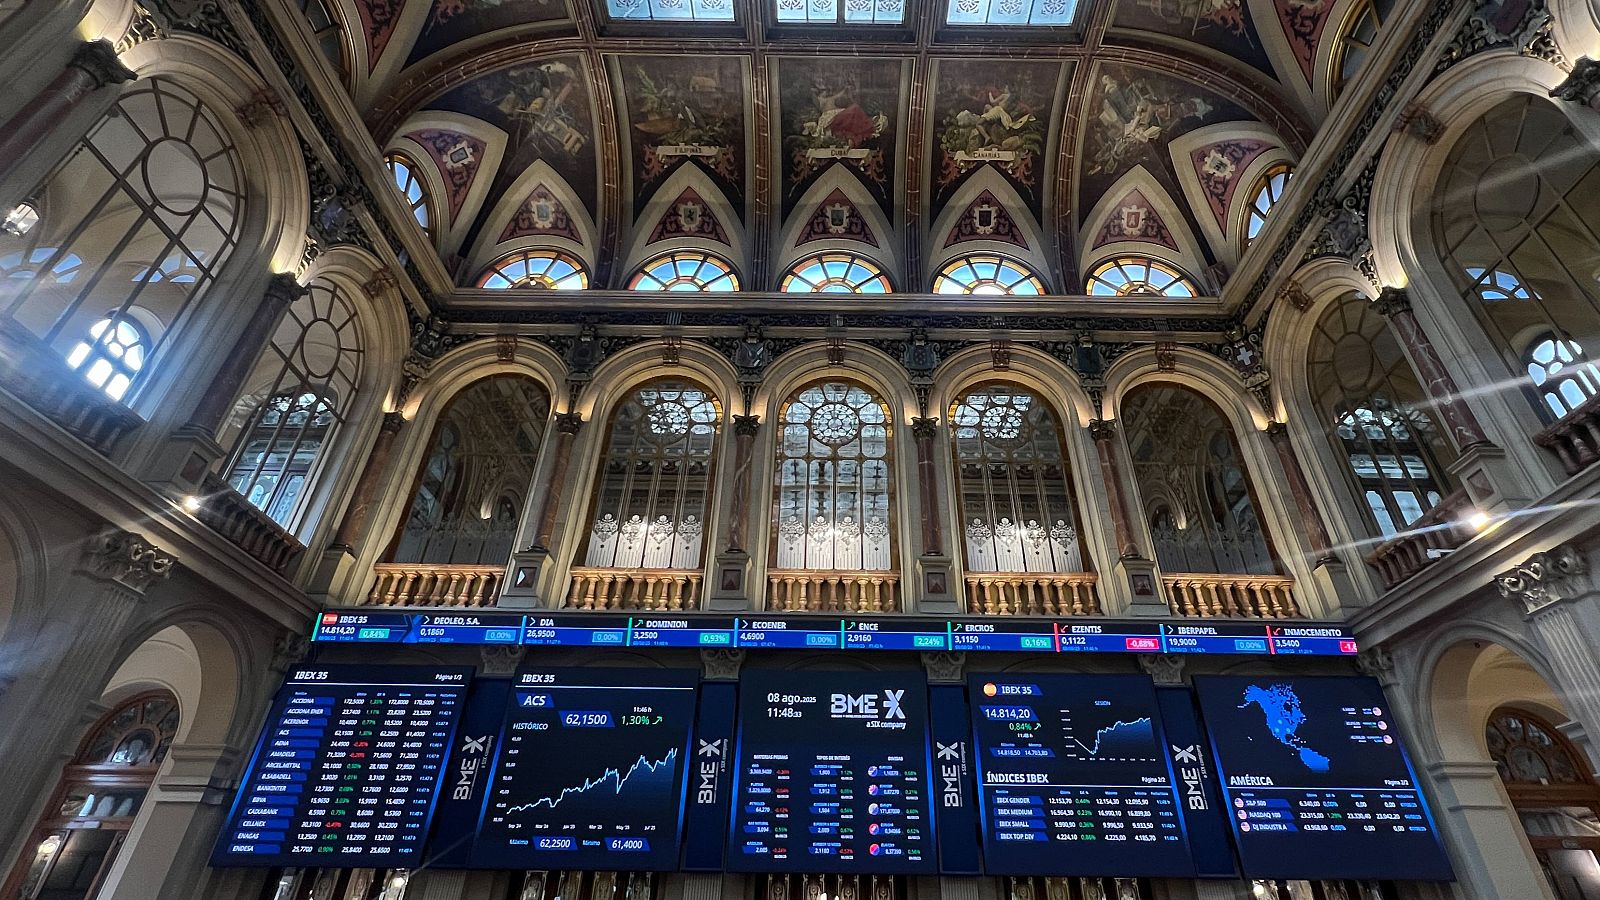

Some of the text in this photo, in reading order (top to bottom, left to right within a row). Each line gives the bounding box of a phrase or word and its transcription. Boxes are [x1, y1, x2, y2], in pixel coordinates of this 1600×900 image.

[434, 618, 465, 626] DEOLEO,
[321, 627, 355, 635] 14.814,20
[420, 628, 444, 636] 0,1860
[527, 630, 555, 638] 26,9500
[955, 636, 978, 644] 3,1150
[1062, 637, 1086, 645] 0,1122
[1169, 638, 1197, 646] 19,9000
[522, 674, 555, 682] IBEX 35
[524, 695, 546, 706] ACS
[768, 693, 779, 703] 08
[831, 694, 878, 714] BME
[986, 709, 1030, 720] 14.814,20
[566, 714, 649, 726] 62,1500 1,30%
[513, 721, 548, 730] HISTÓRICO
[453, 758, 477, 800] BME
[986, 771, 1025, 782] ÍNDICES
[1026, 774, 1049, 783] IBEX
[1230, 774, 1274, 785] AMÉRICA
[698, 762, 715, 804] BME
[942, 765, 959, 806] BME
[1181, 768, 1205, 809] BME
[540, 840, 570, 848] 62,2500
[612, 840, 642, 849] 61,4000
